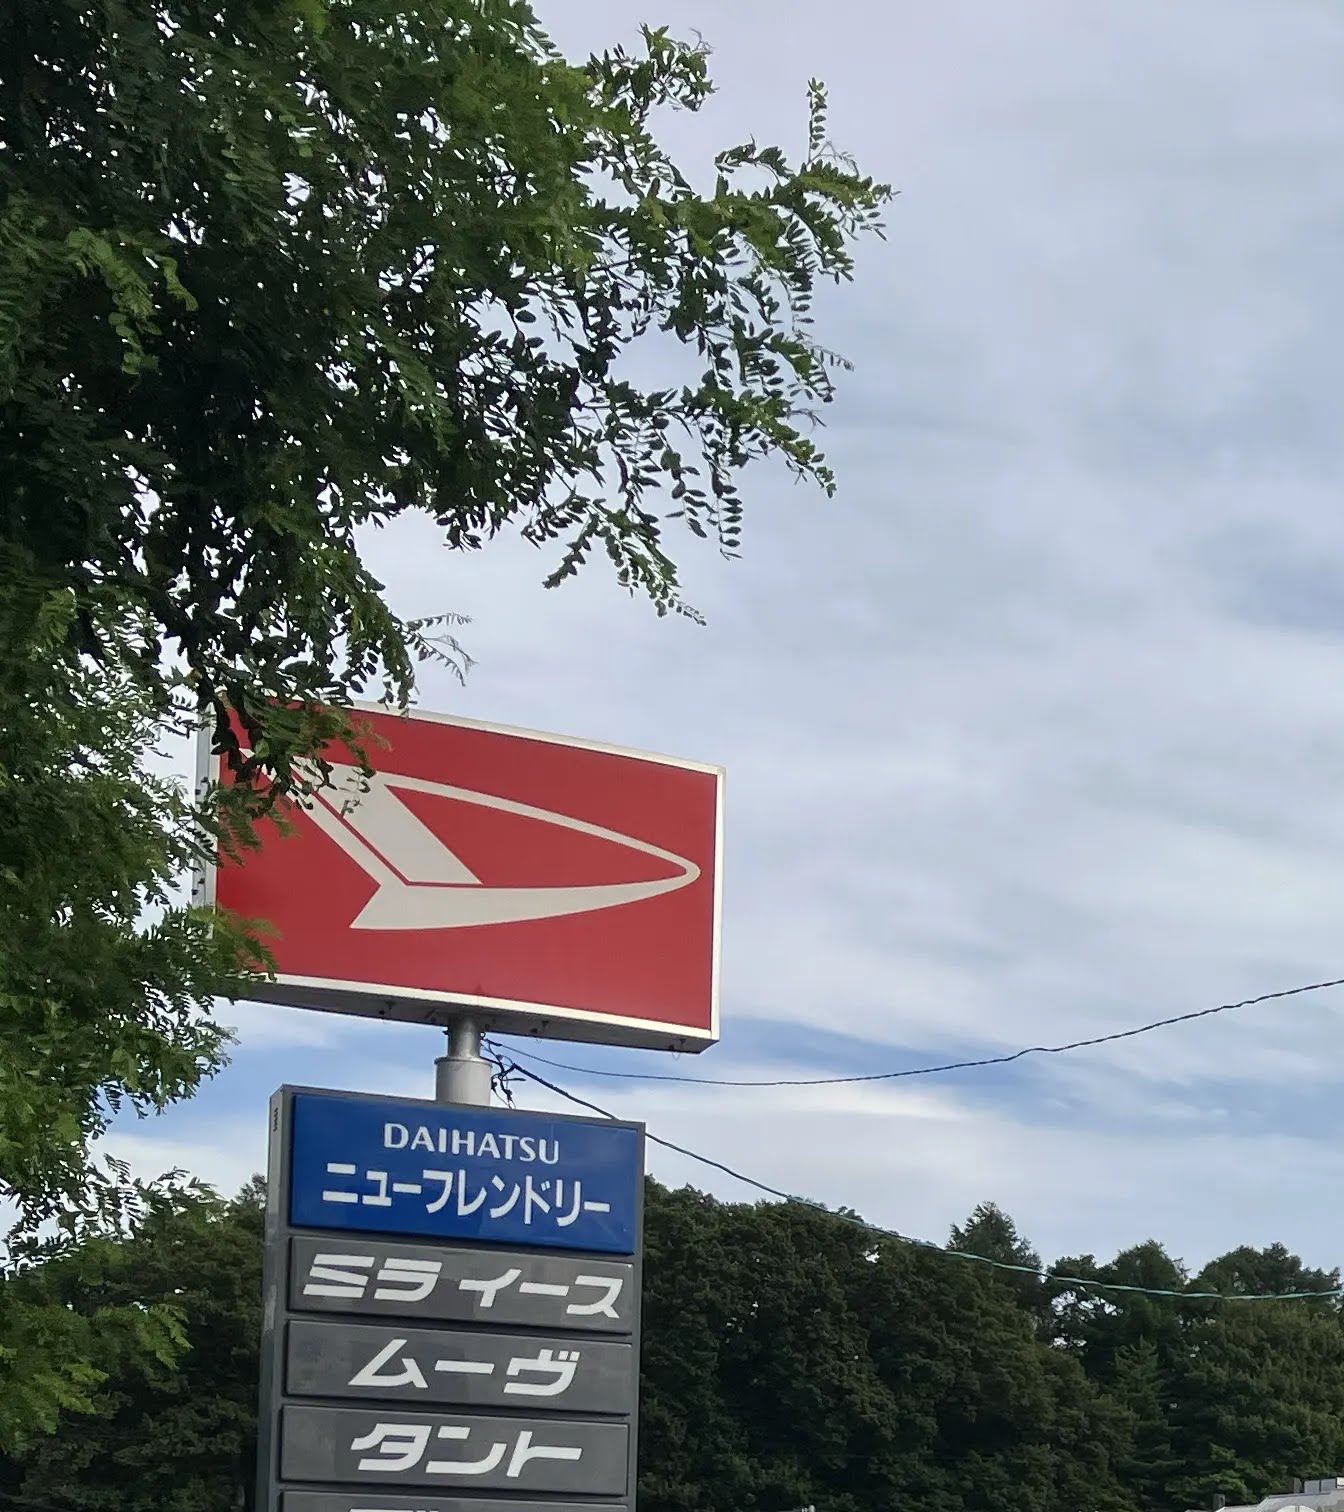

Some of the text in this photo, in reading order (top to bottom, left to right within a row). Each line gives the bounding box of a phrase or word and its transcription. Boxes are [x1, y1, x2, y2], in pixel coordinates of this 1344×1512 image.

[383, 1122, 561, 1165] DAIHATSU
[322, 1163, 611, 1227] ニューフレンドリー
[348, 1338, 581, 1397] ムーヴ
[350, 1422, 583, 1478] タント
